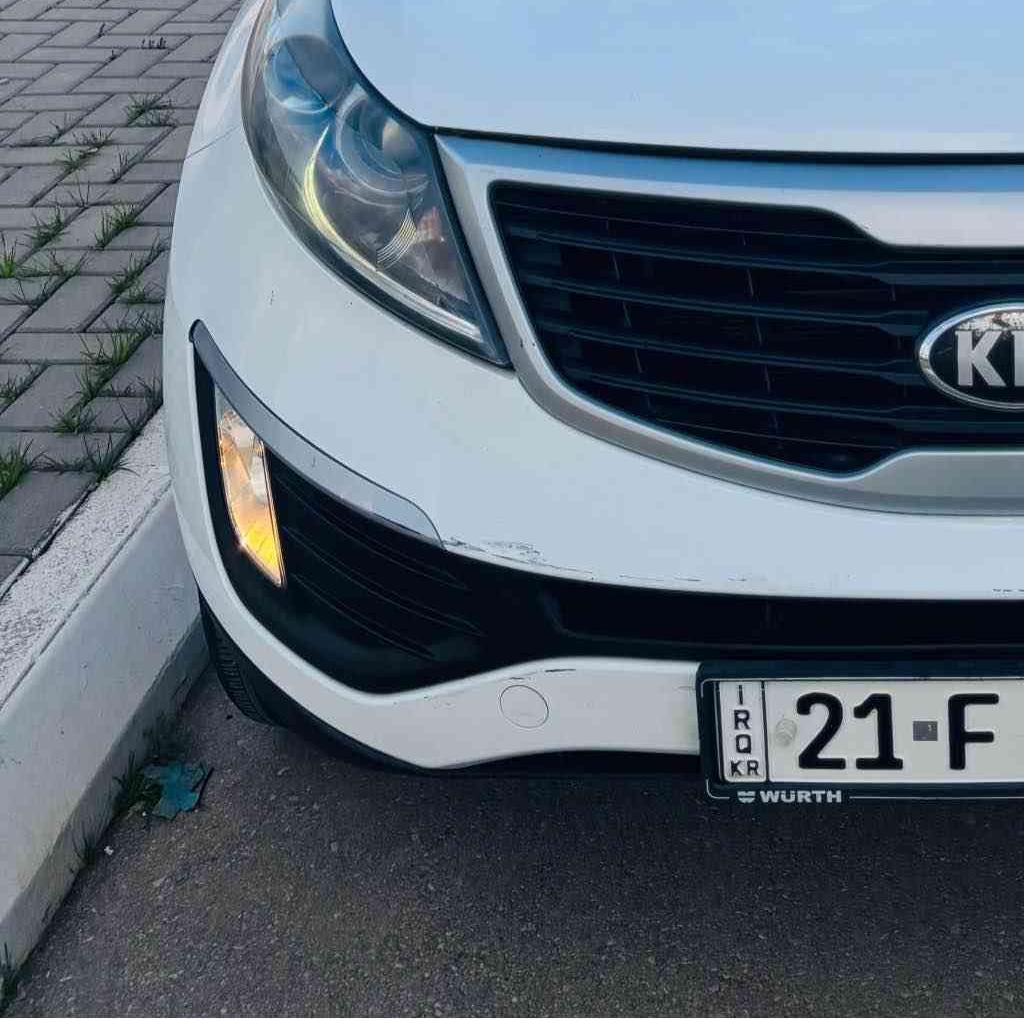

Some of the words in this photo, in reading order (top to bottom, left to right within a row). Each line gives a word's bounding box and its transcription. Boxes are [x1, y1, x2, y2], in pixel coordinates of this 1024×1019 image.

[797, 691, 904, 770] 21
[947, 692, 1000, 770] F
[730, 759, 759, 777] KR
